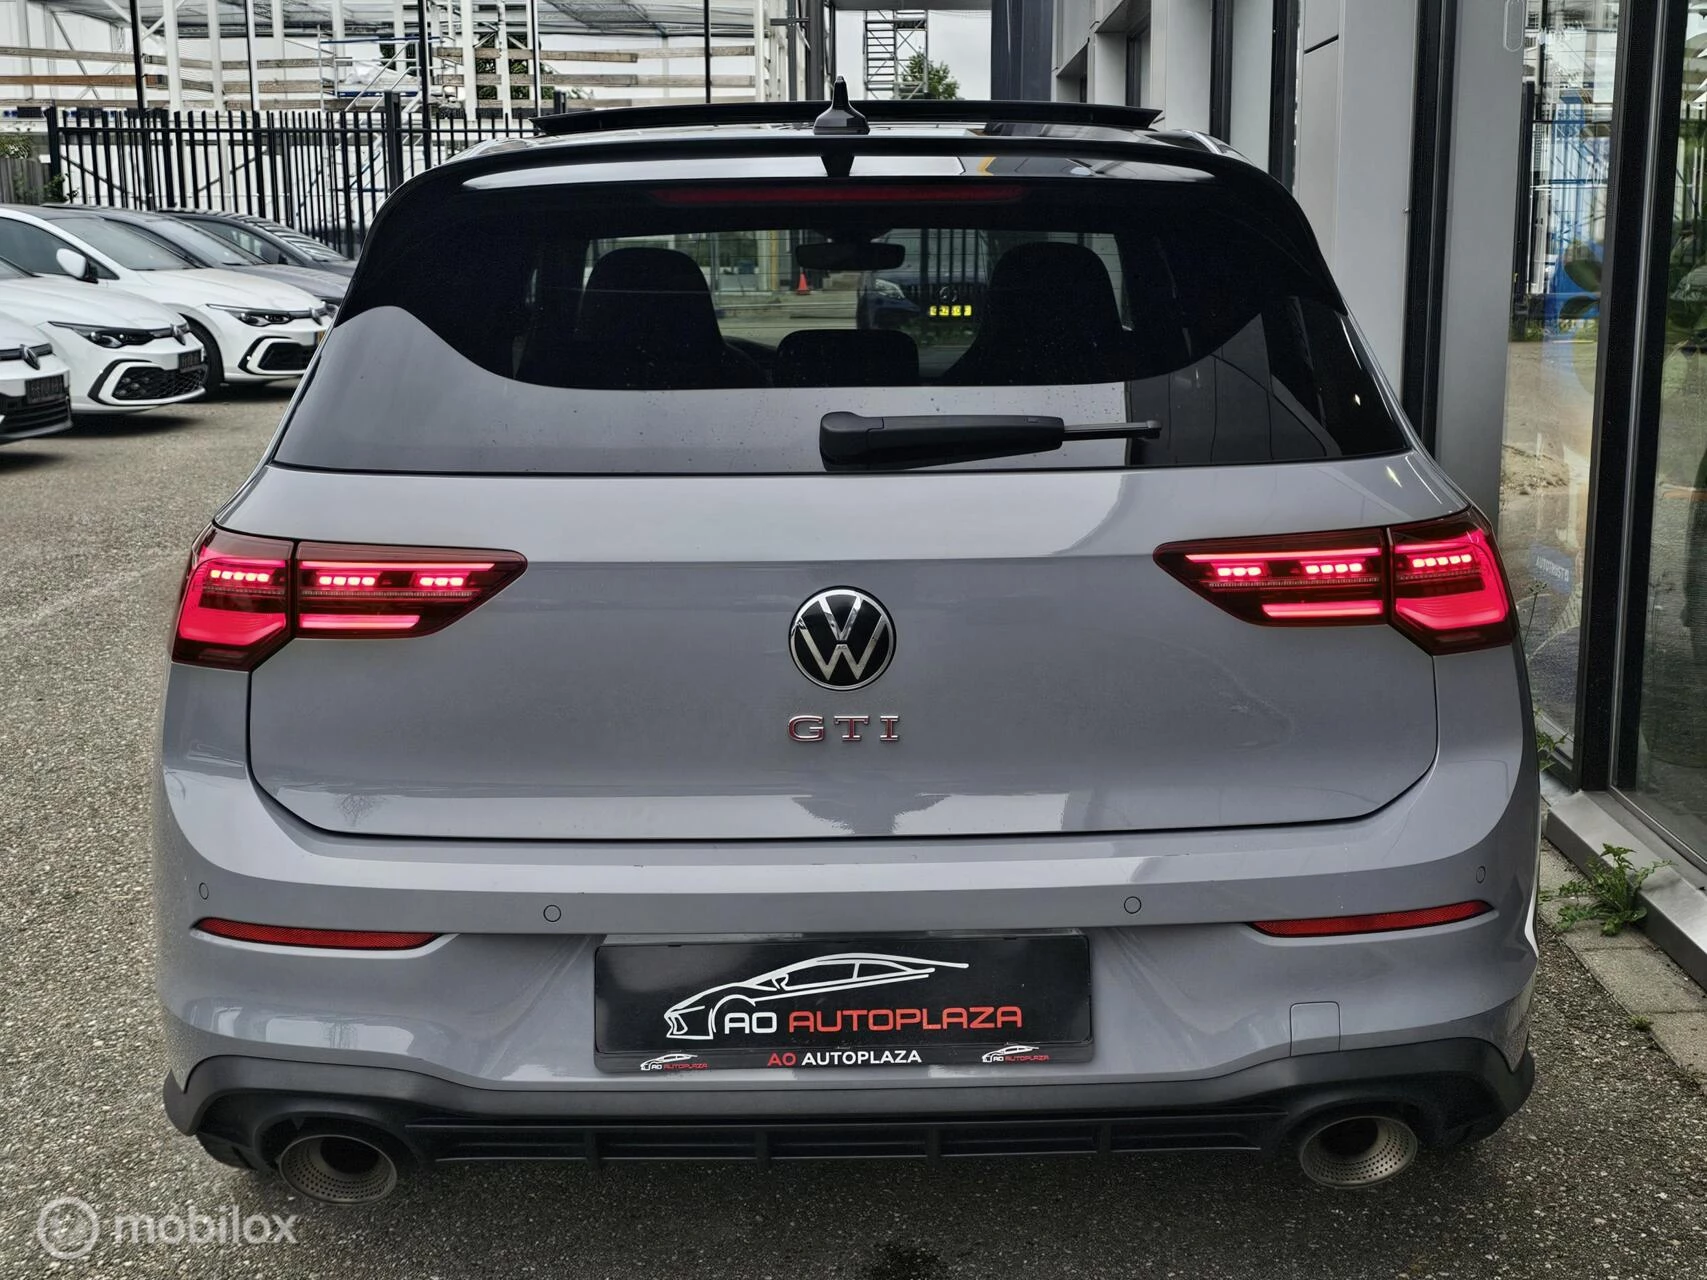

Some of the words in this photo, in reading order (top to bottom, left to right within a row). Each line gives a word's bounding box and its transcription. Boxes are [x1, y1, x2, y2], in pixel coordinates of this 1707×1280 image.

[787, 714, 900, 742] GTI
[724, 1011, 778, 1034] AO
[788, 1005, 1023, 1033] AUTOPLAZA
[663, 1062, 709, 1070] AUTOPLAZA
[767, 1052, 797, 1066] AO
[801, 1049, 922, 1066] AUTOPLAZA
[1005, 1054, 1050, 1063] AUTOPLAZA
